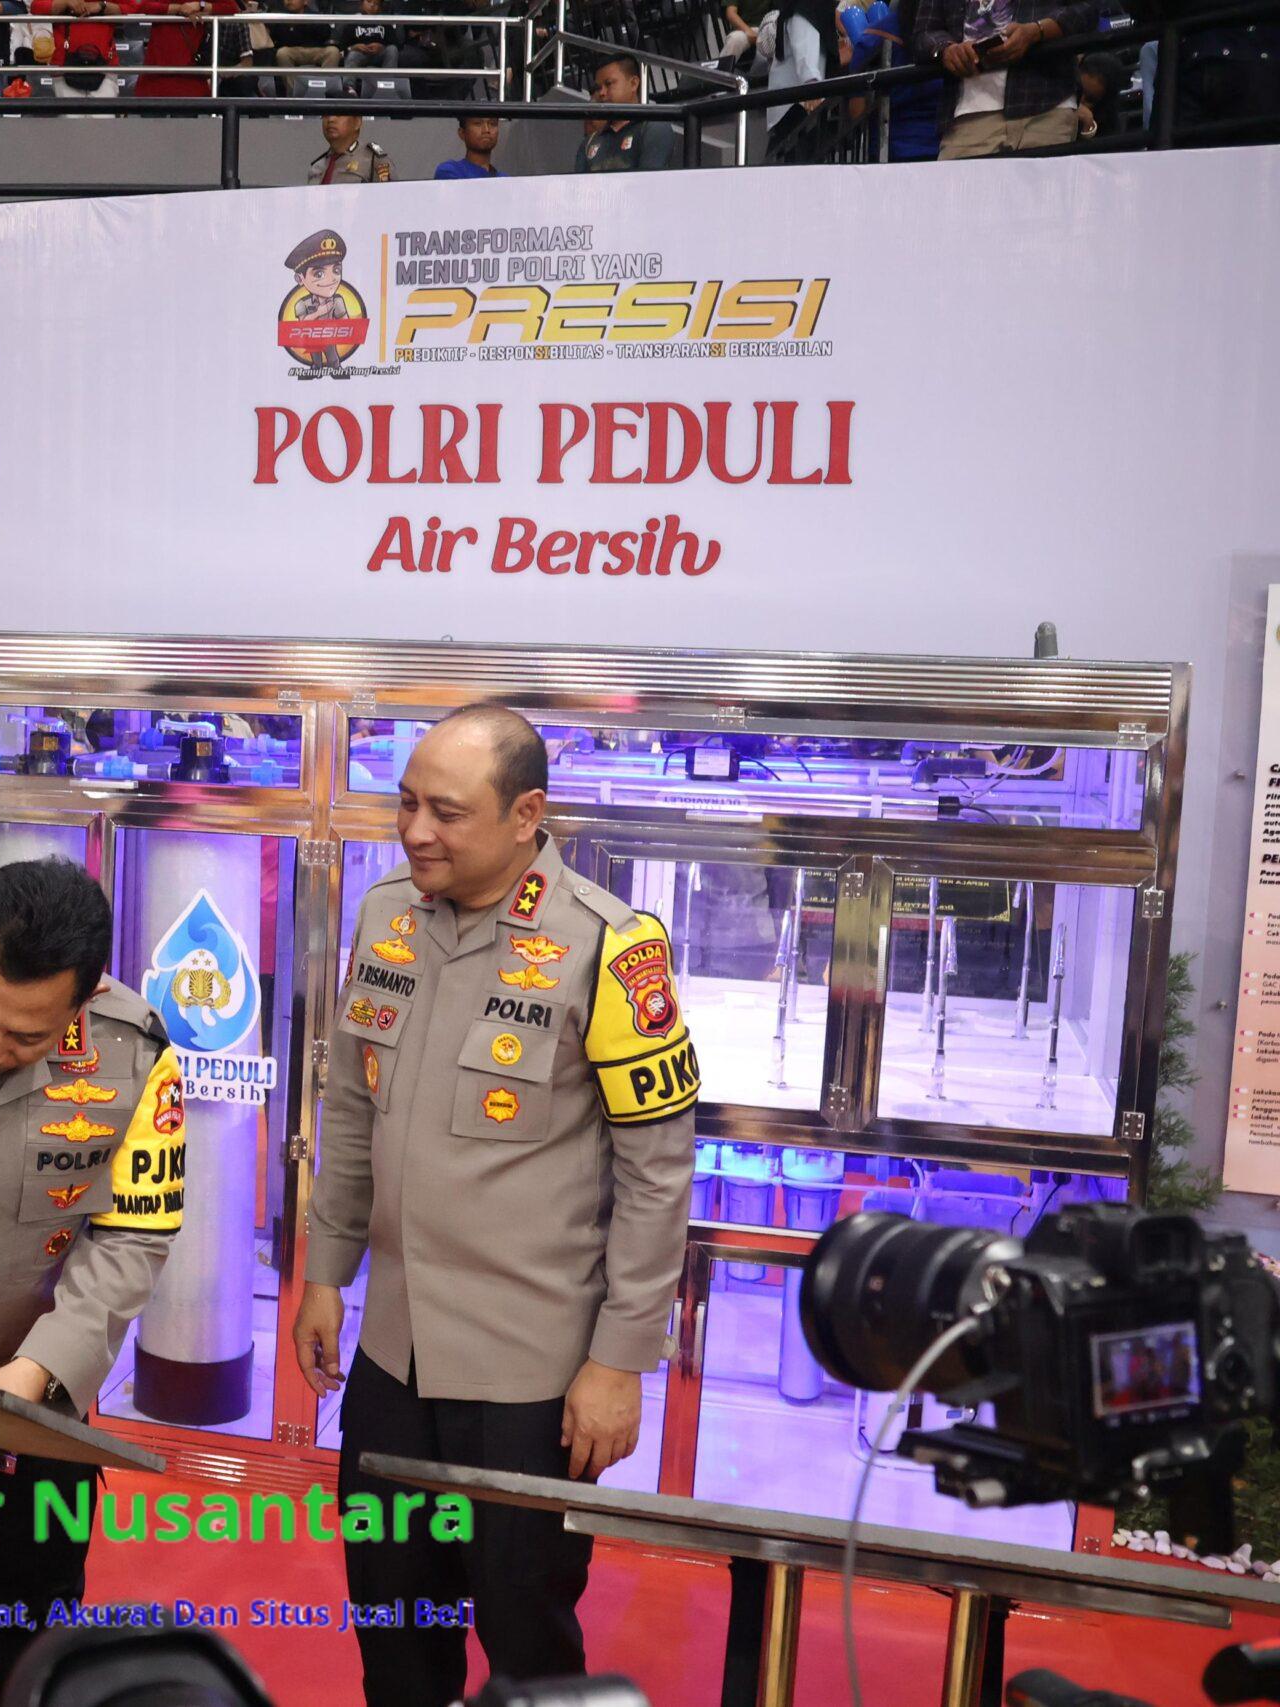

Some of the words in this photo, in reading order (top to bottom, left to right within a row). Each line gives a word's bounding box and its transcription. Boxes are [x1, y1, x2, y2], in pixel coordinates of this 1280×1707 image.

[395, 225, 594, 257] TRANSFORMASI
[395, 258, 501, 286] MENUJU
[507, 254, 586, 283] POLRI
[591, 252, 663, 280] YANG
[395, 277, 831, 345] PRESISI
[288, 326, 355, 339] PRESISI
[394, 345, 468, 362] PREDIKTIF
[478, 344, 604, 362] RESPONSIBILITAS
[615, 342, 726, 359] TRANSPARANSI
[729, 341, 833, 358] BERKEADILAN
[253, 403, 504, 485] POLRI
[537, 401, 856, 485] PEDULI
[366, 516, 478, 573] Air
[491, 514, 722, 576] Bersih
[618, 945, 663, 974] POLDA
[357, 963, 416, 997] P.RISMANTO
[484, 997, 553, 1029] POLRI
[196, 1057, 272, 1085] PEDULI
[629, 1042, 700, 1106] PJKO
[185, 1080, 261, 1101] Bersih
[36, 1147, 111, 1172] POLRI
